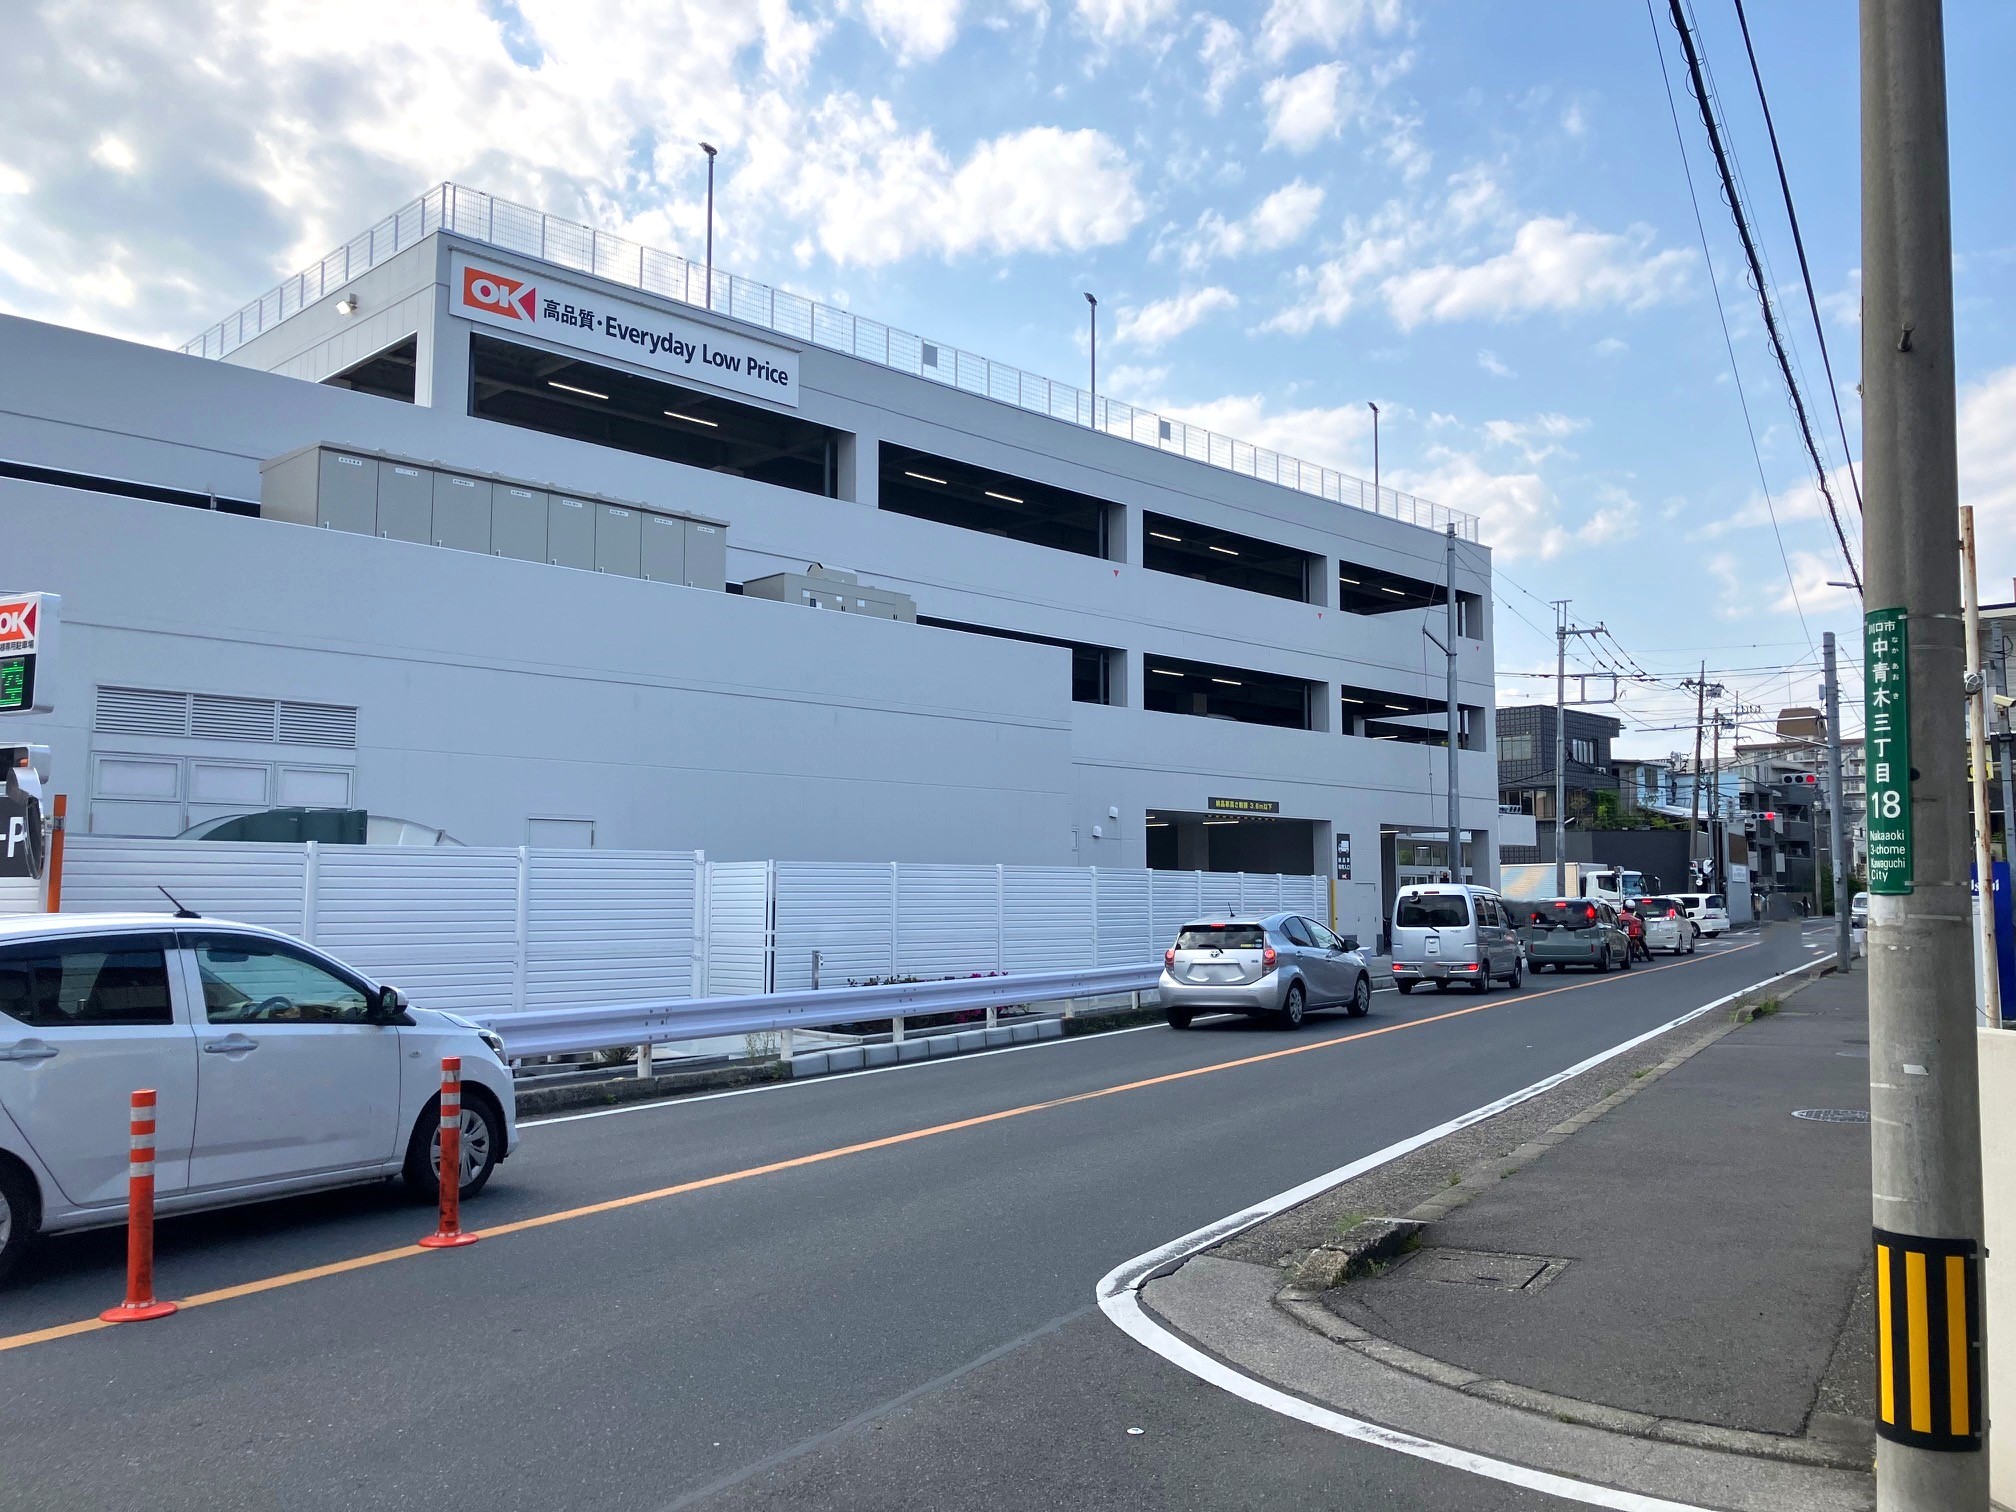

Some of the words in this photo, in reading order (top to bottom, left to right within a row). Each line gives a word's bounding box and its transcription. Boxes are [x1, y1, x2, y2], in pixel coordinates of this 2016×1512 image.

[469, 274, 535, 322] OK
[702, 344, 741, 372] Low
[747, 356, 789, 386] Price
[0, 606, 35, 639] OK
[1868, 621, 1896, 635] 川口市
[1872, 637, 1892, 783] 中青木三丁目
[1871, 790, 1901, 819] 18
[1870, 829, 1905, 841] Nakaaoki
[1870, 844, 1906, 855] 3-chome
[1870, 857, 1906, 871] Kawaguchi
[1870, 869, 1889, 882] City
